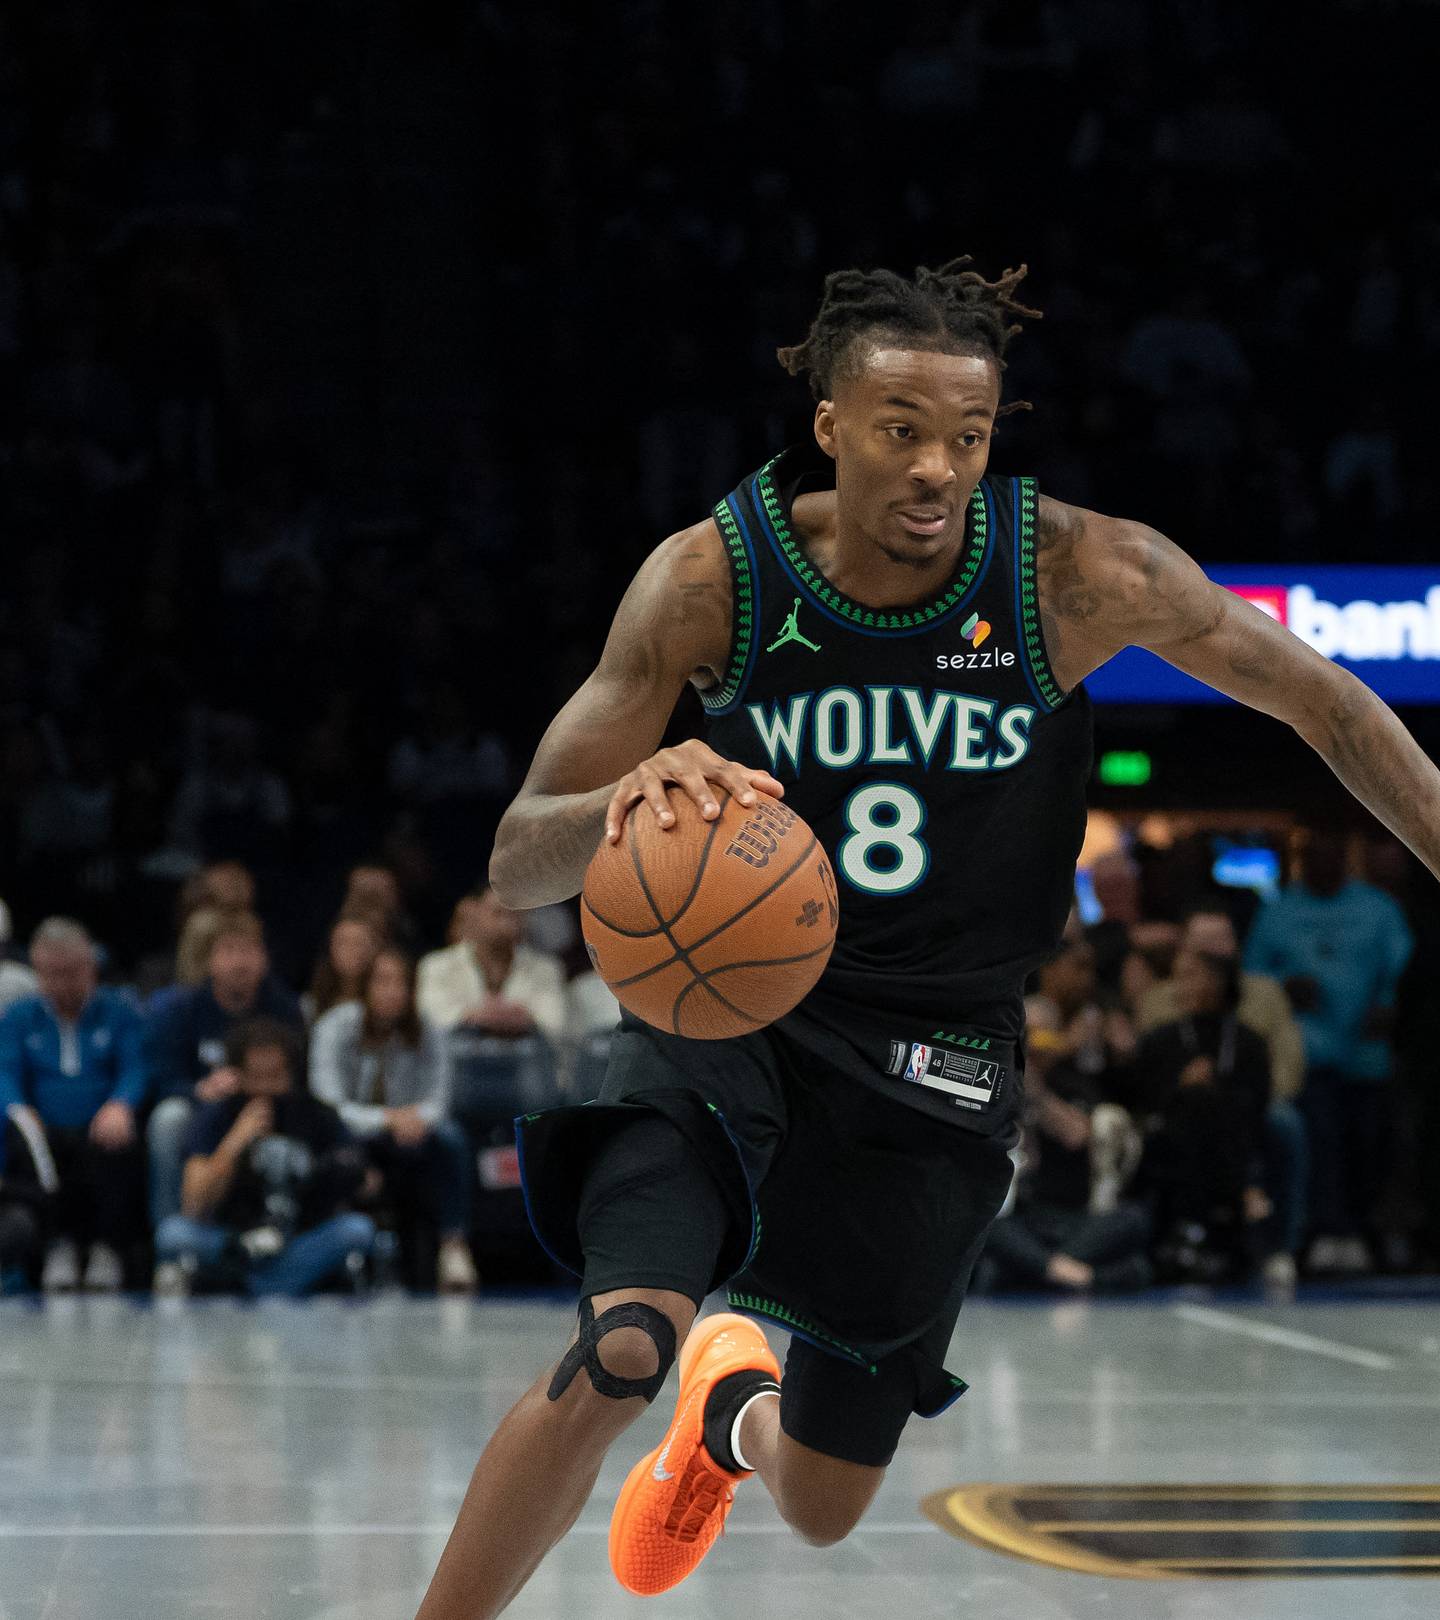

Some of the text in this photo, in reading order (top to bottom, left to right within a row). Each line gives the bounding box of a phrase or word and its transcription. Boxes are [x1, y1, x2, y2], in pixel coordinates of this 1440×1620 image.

[935, 646, 1016, 670] sezzle
[747, 684, 1037, 776] WOLVES
[838, 782, 930, 893] 8
[932, 1057, 943, 1069] 46
